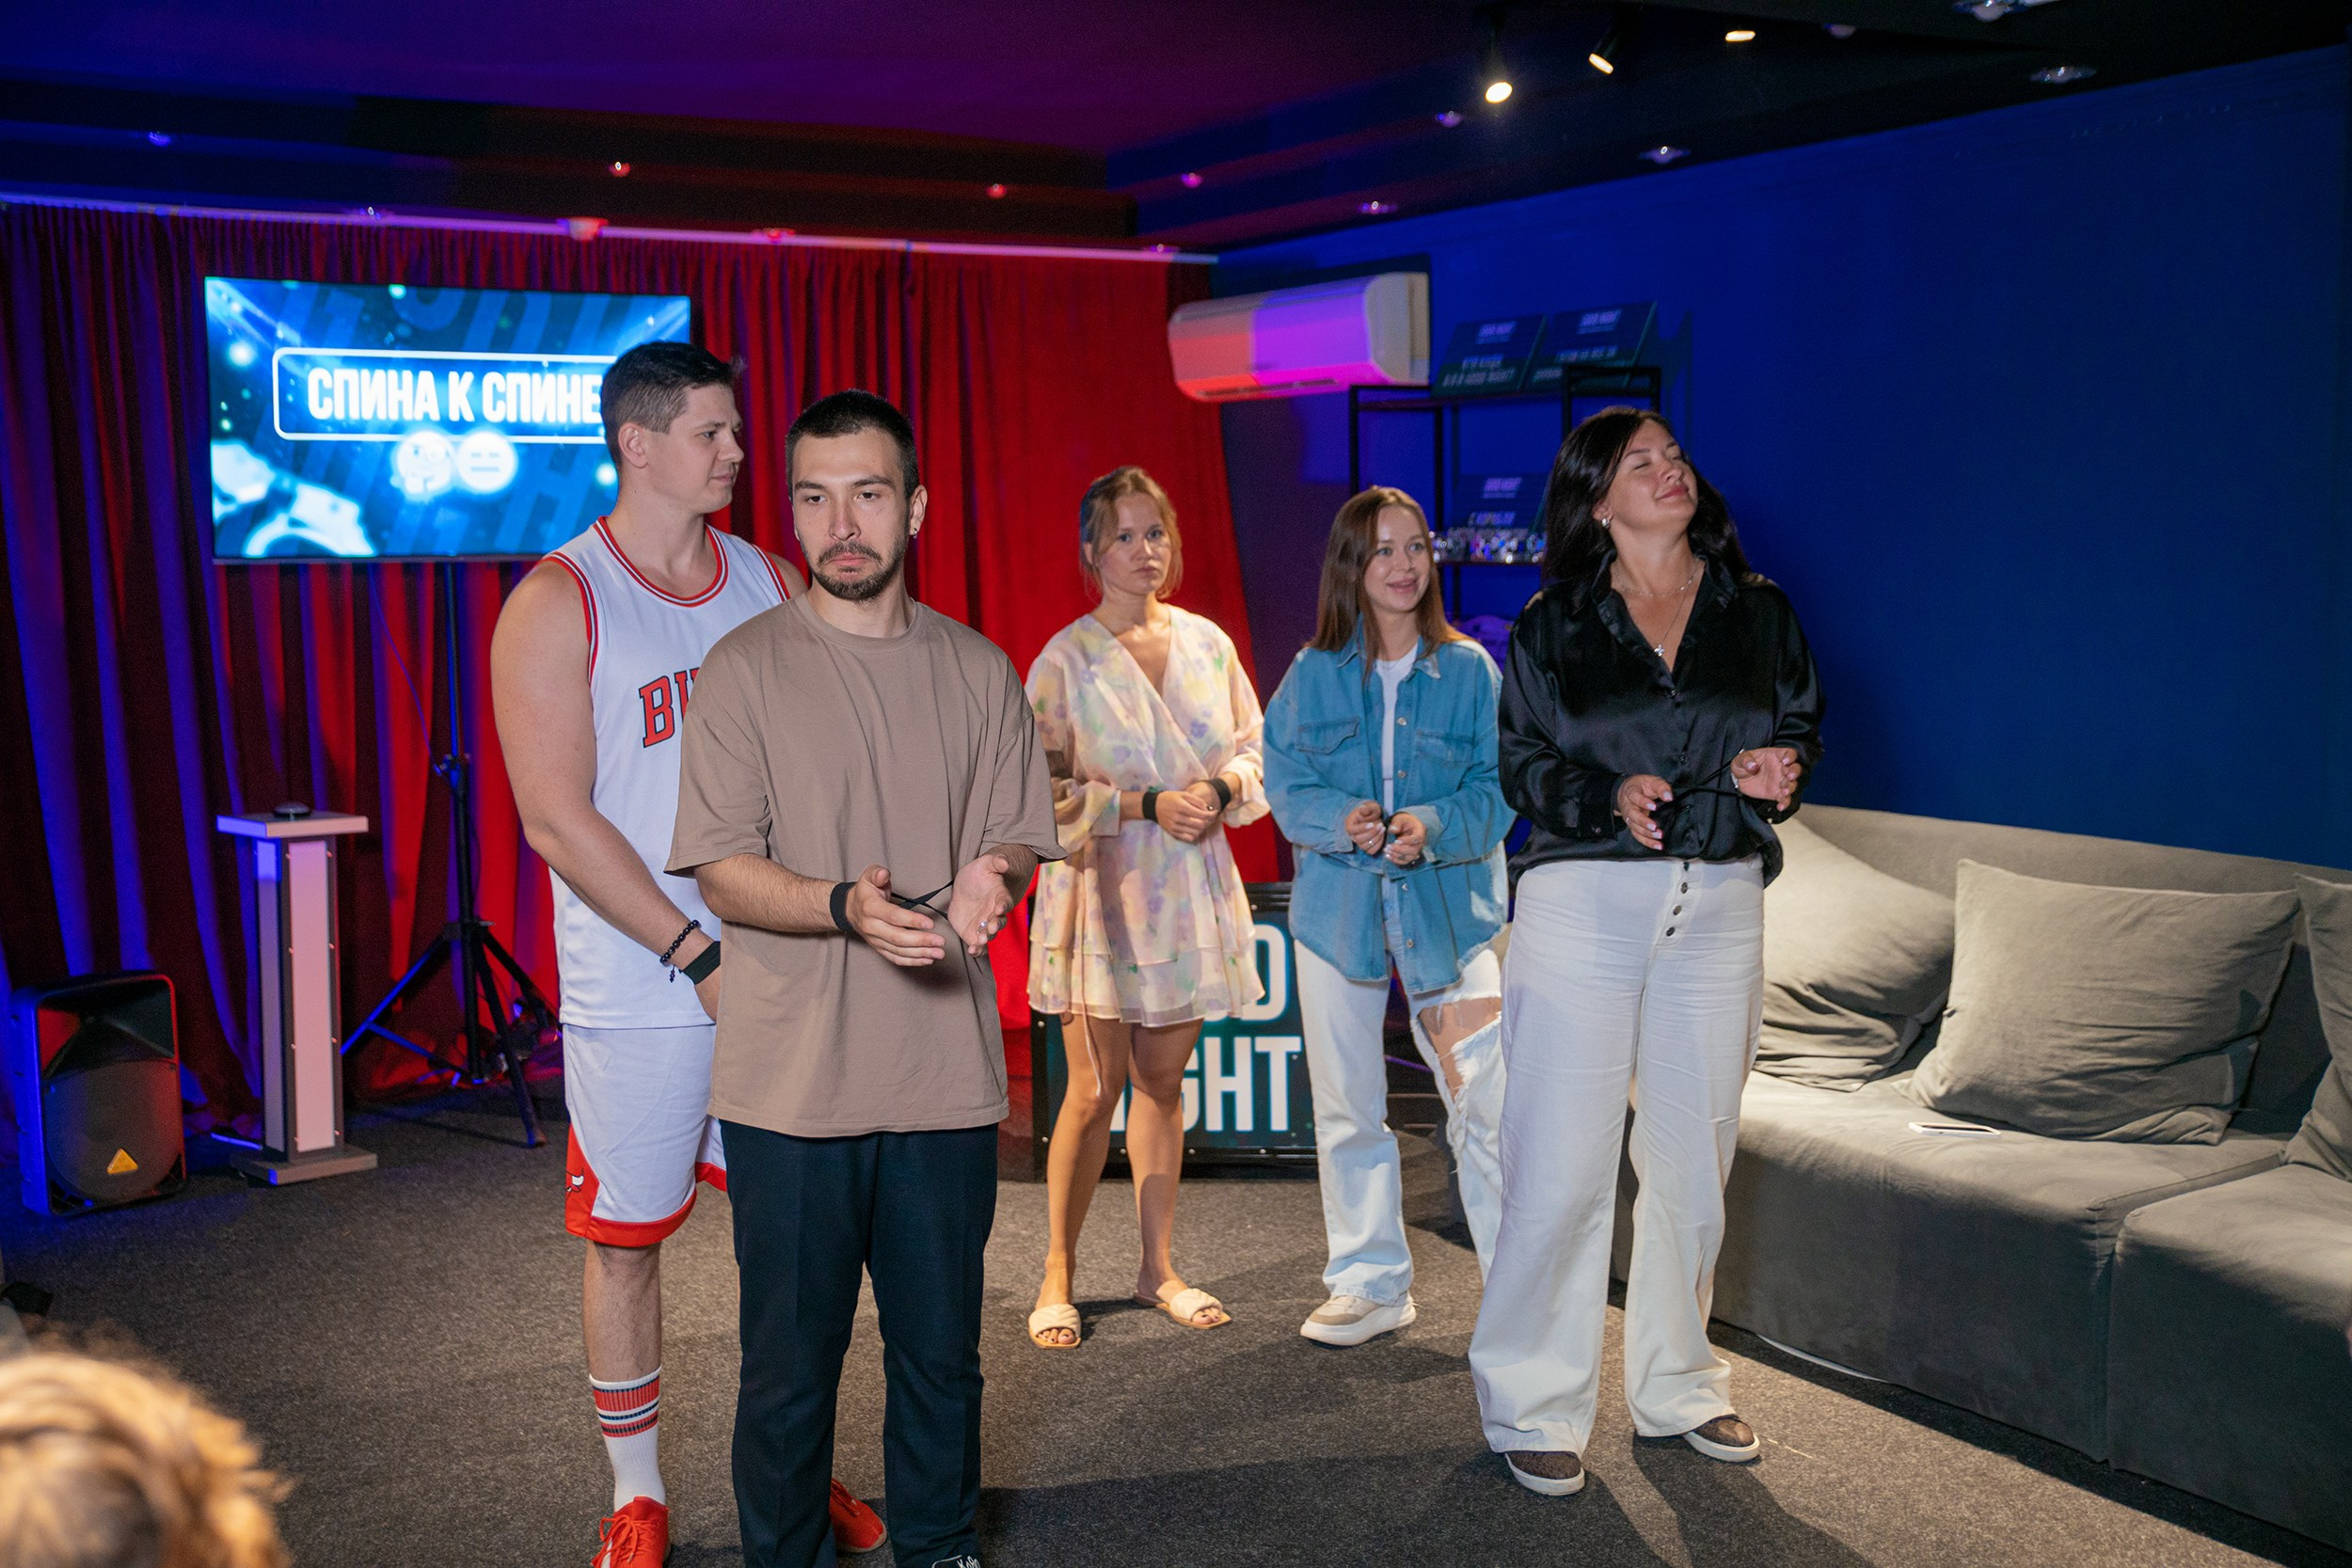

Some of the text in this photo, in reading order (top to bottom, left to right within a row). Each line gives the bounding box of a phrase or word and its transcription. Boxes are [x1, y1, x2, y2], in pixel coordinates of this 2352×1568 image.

[308, 367, 603, 424] СПИНА К СПИНЕ
